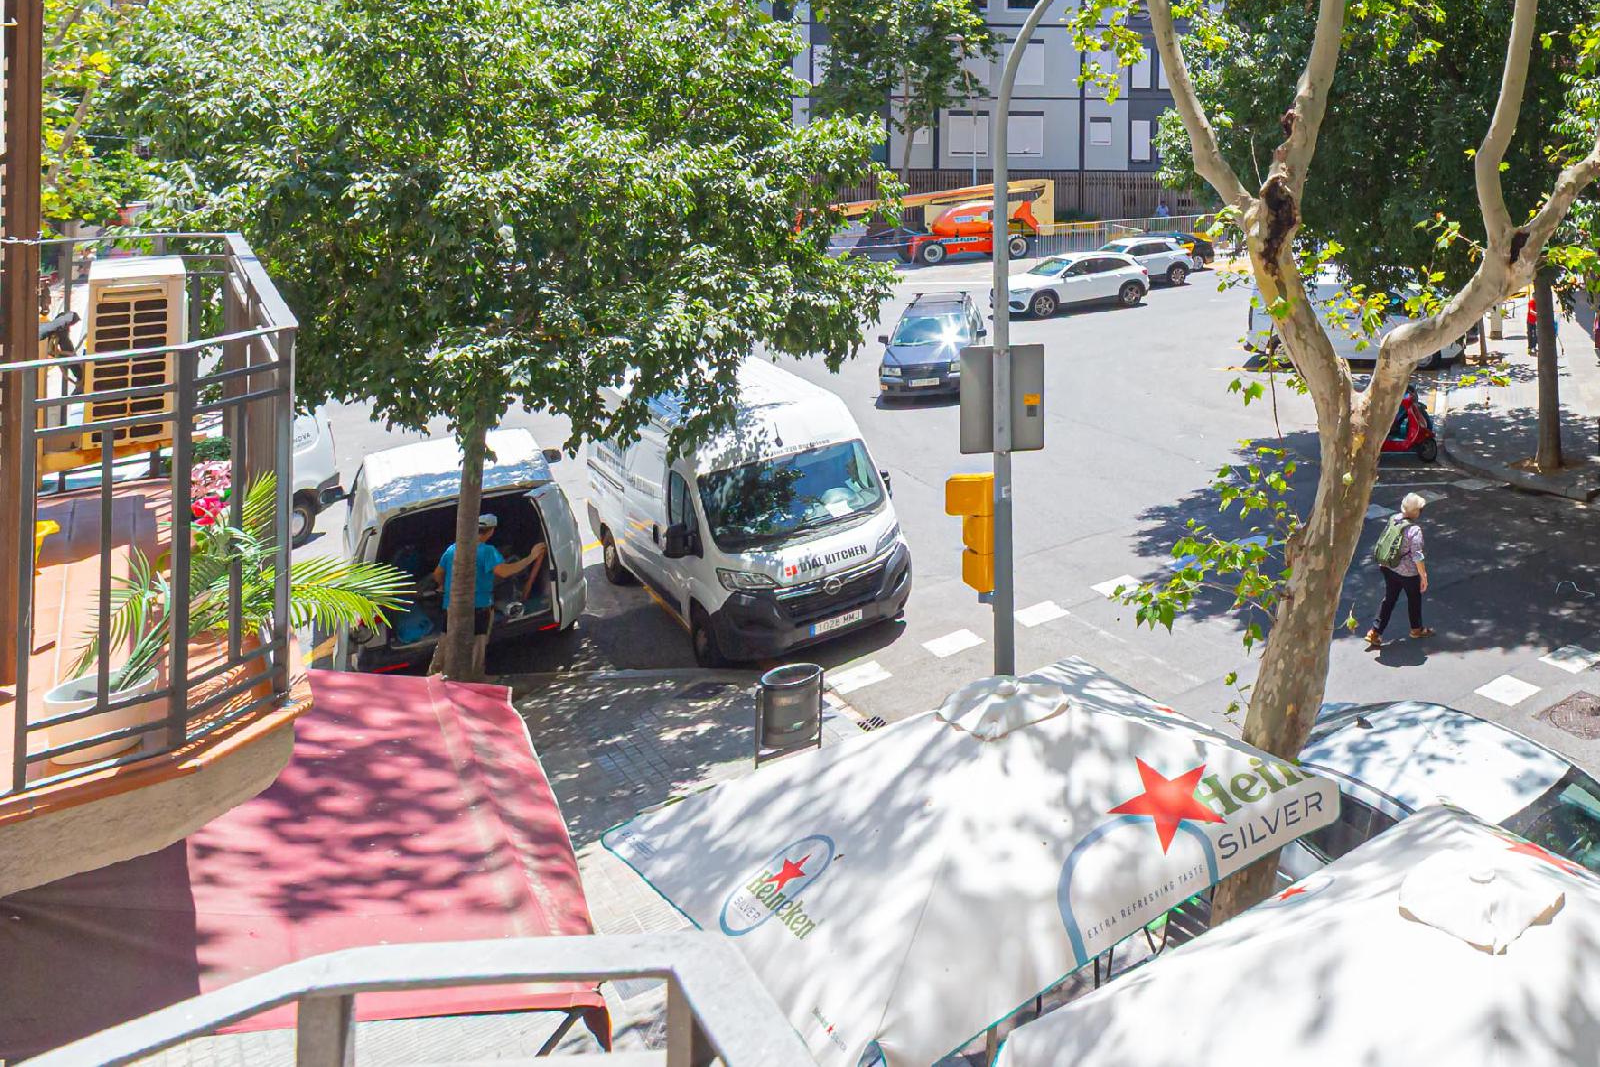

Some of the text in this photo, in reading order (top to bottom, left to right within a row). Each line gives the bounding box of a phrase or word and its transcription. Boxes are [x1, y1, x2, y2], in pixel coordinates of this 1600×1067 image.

[800, 544, 868, 573] DIAL KITCHEN
[1218, 791, 1323, 860] SILVER
[746, 870, 816, 940] Heineken
[1087, 864, 1204, 939] EXTRA REFRESHING TASTE
